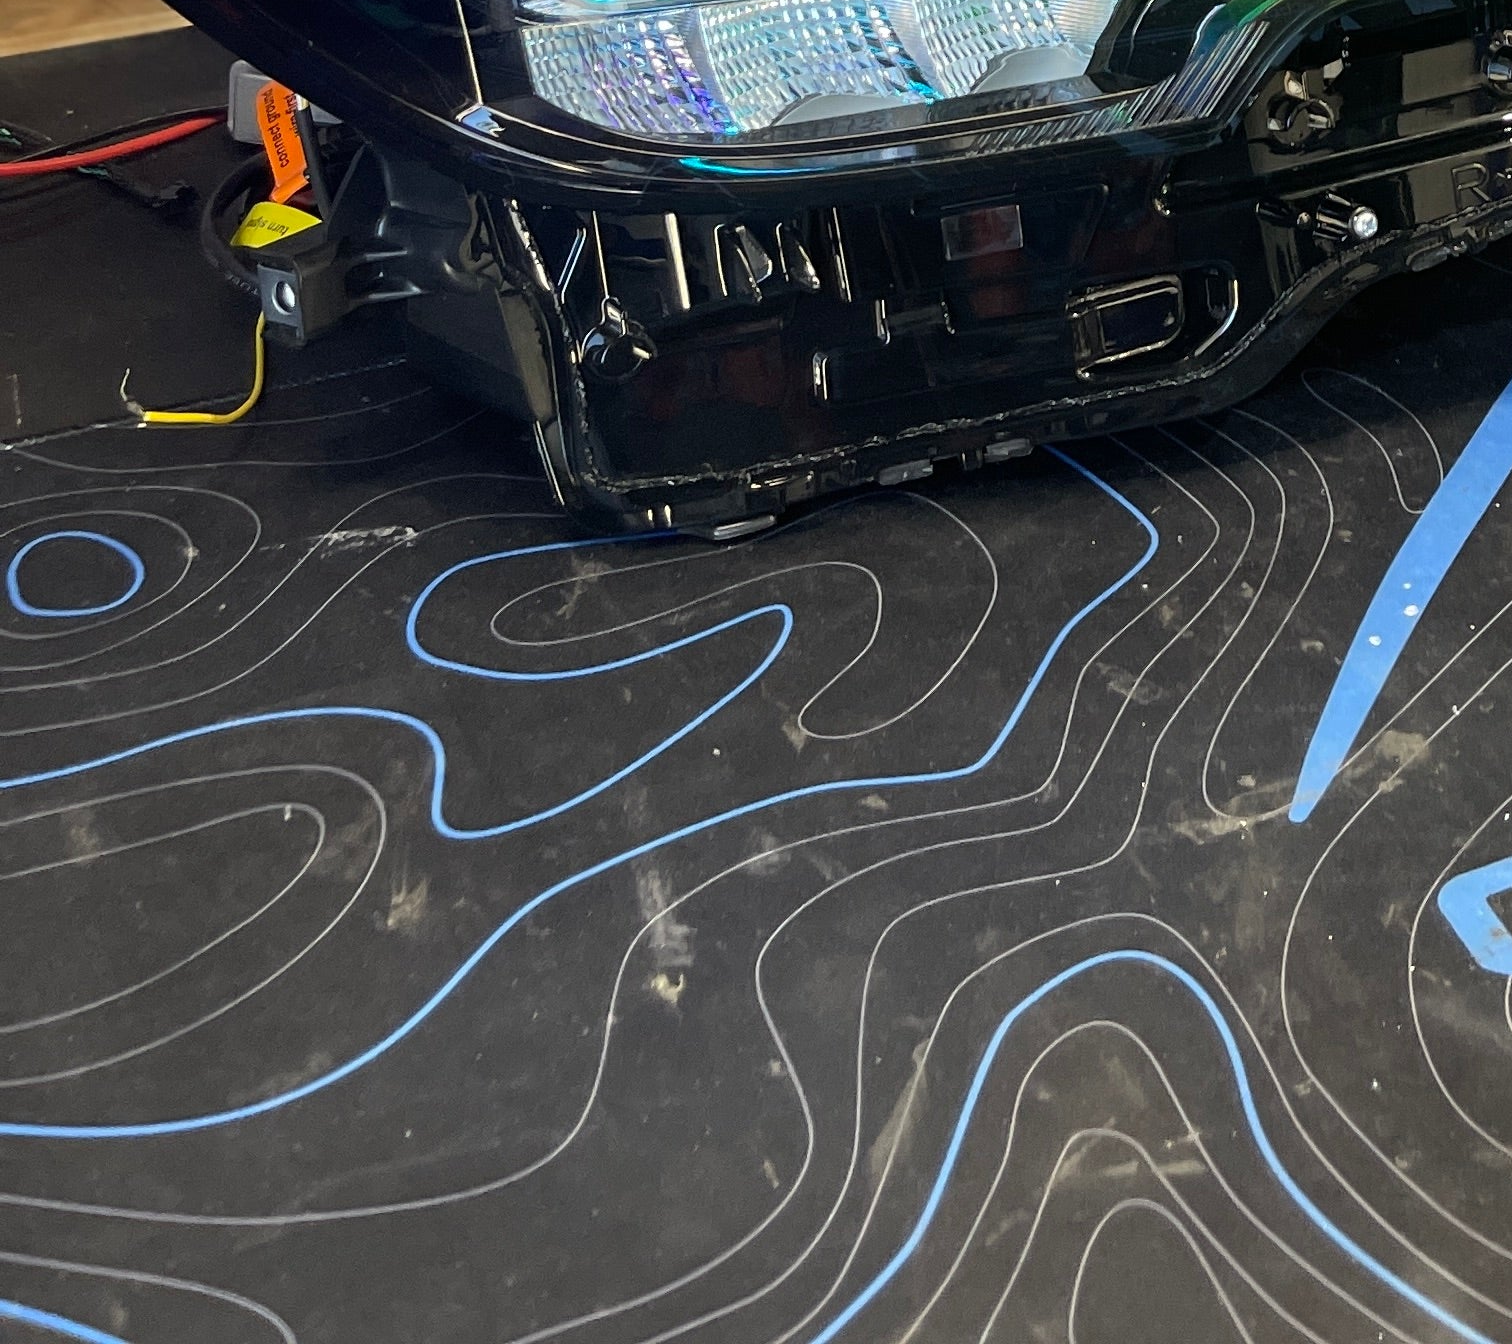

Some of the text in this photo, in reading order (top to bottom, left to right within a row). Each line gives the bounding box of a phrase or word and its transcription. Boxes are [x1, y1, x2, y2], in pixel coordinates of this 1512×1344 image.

[261, 87, 291, 169] connect ground
[267, 223, 291, 238] turn
